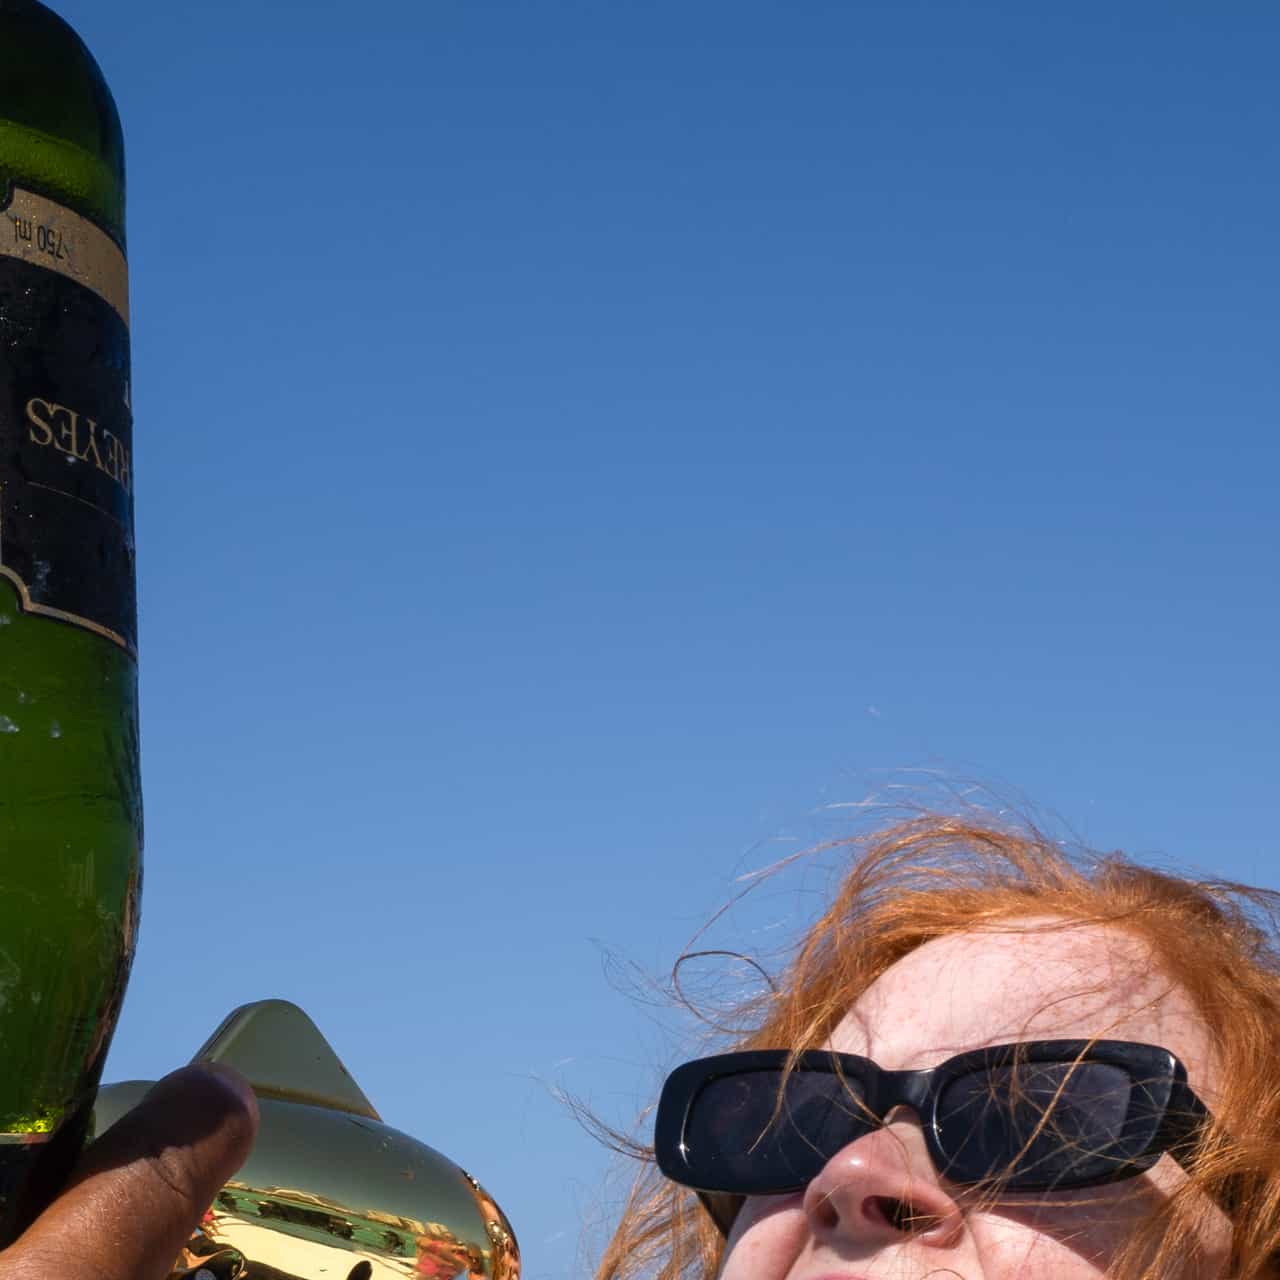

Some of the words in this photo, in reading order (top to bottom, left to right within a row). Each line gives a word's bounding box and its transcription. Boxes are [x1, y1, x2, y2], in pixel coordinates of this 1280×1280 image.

[15, 216, 33, 242] ml
[37, 226, 65, 259] 750
[25, 397, 130, 497] REYES
